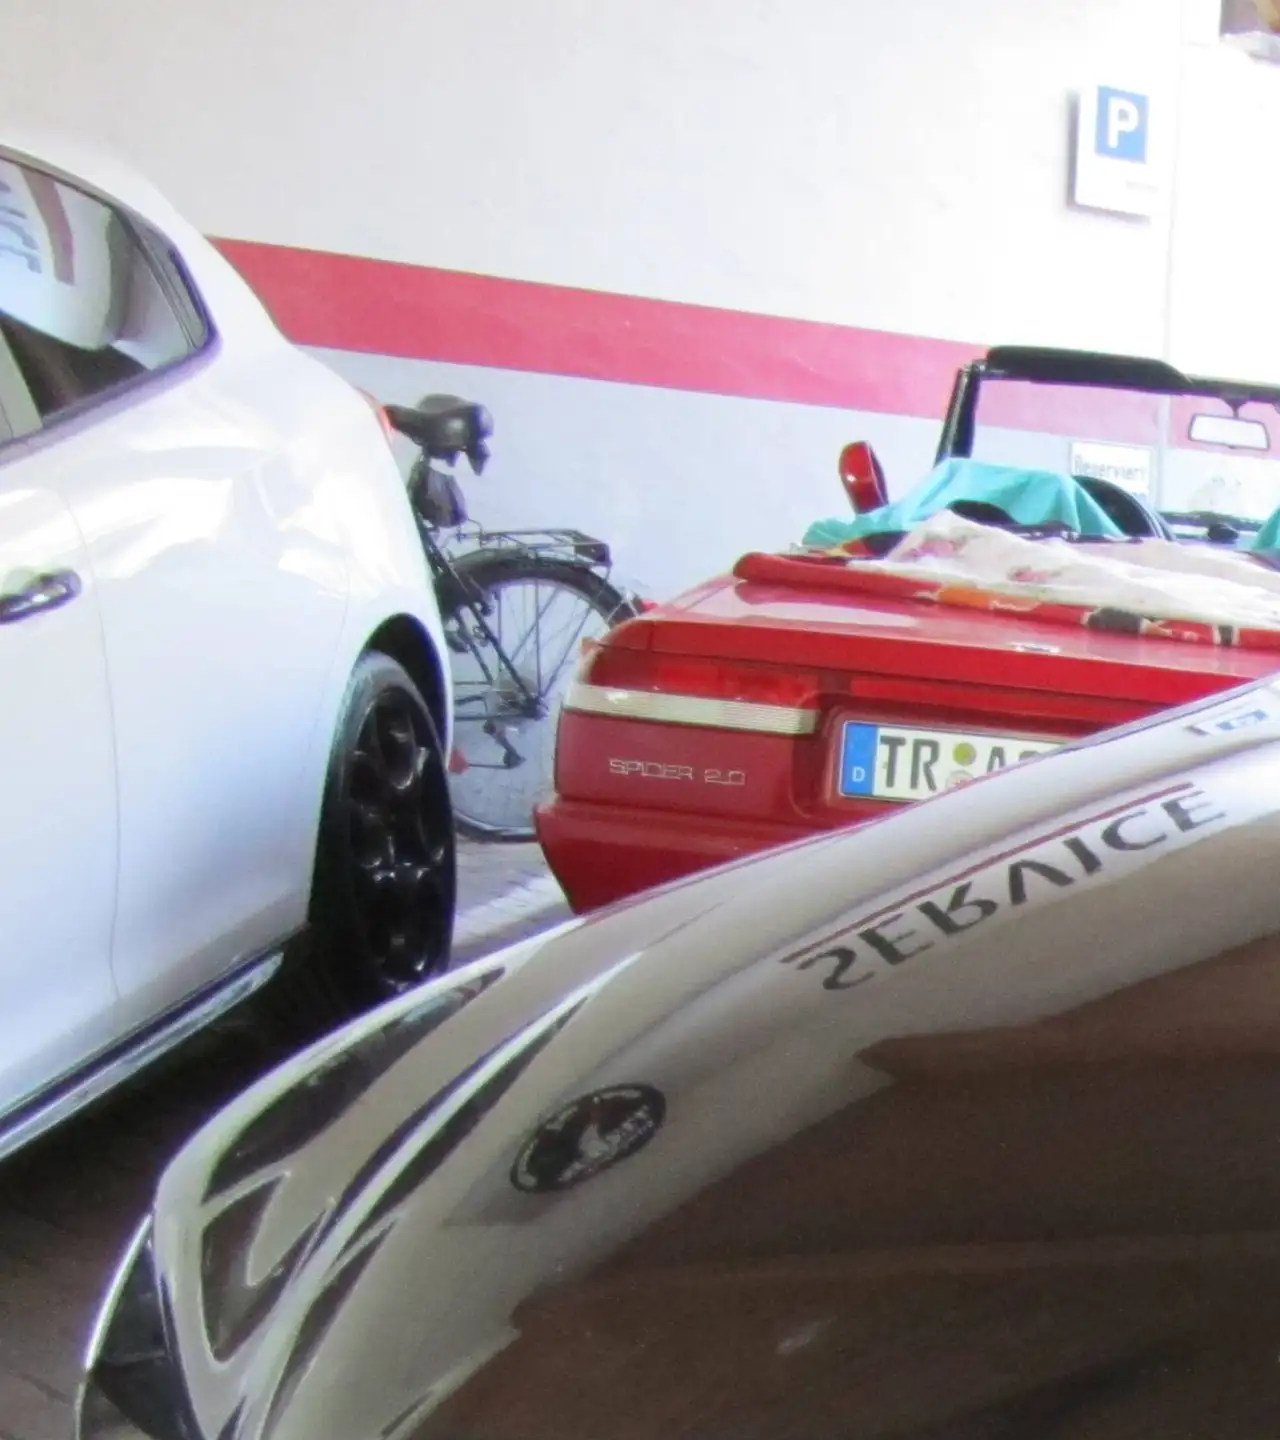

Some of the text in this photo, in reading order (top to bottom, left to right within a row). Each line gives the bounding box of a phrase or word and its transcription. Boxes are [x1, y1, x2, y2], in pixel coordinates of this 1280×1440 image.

[1108, 97, 1139, 149] P
[608, 756, 694, 781] SPIDER
[852, 766, 866, 782] D
[879, 735, 940, 791] TR
